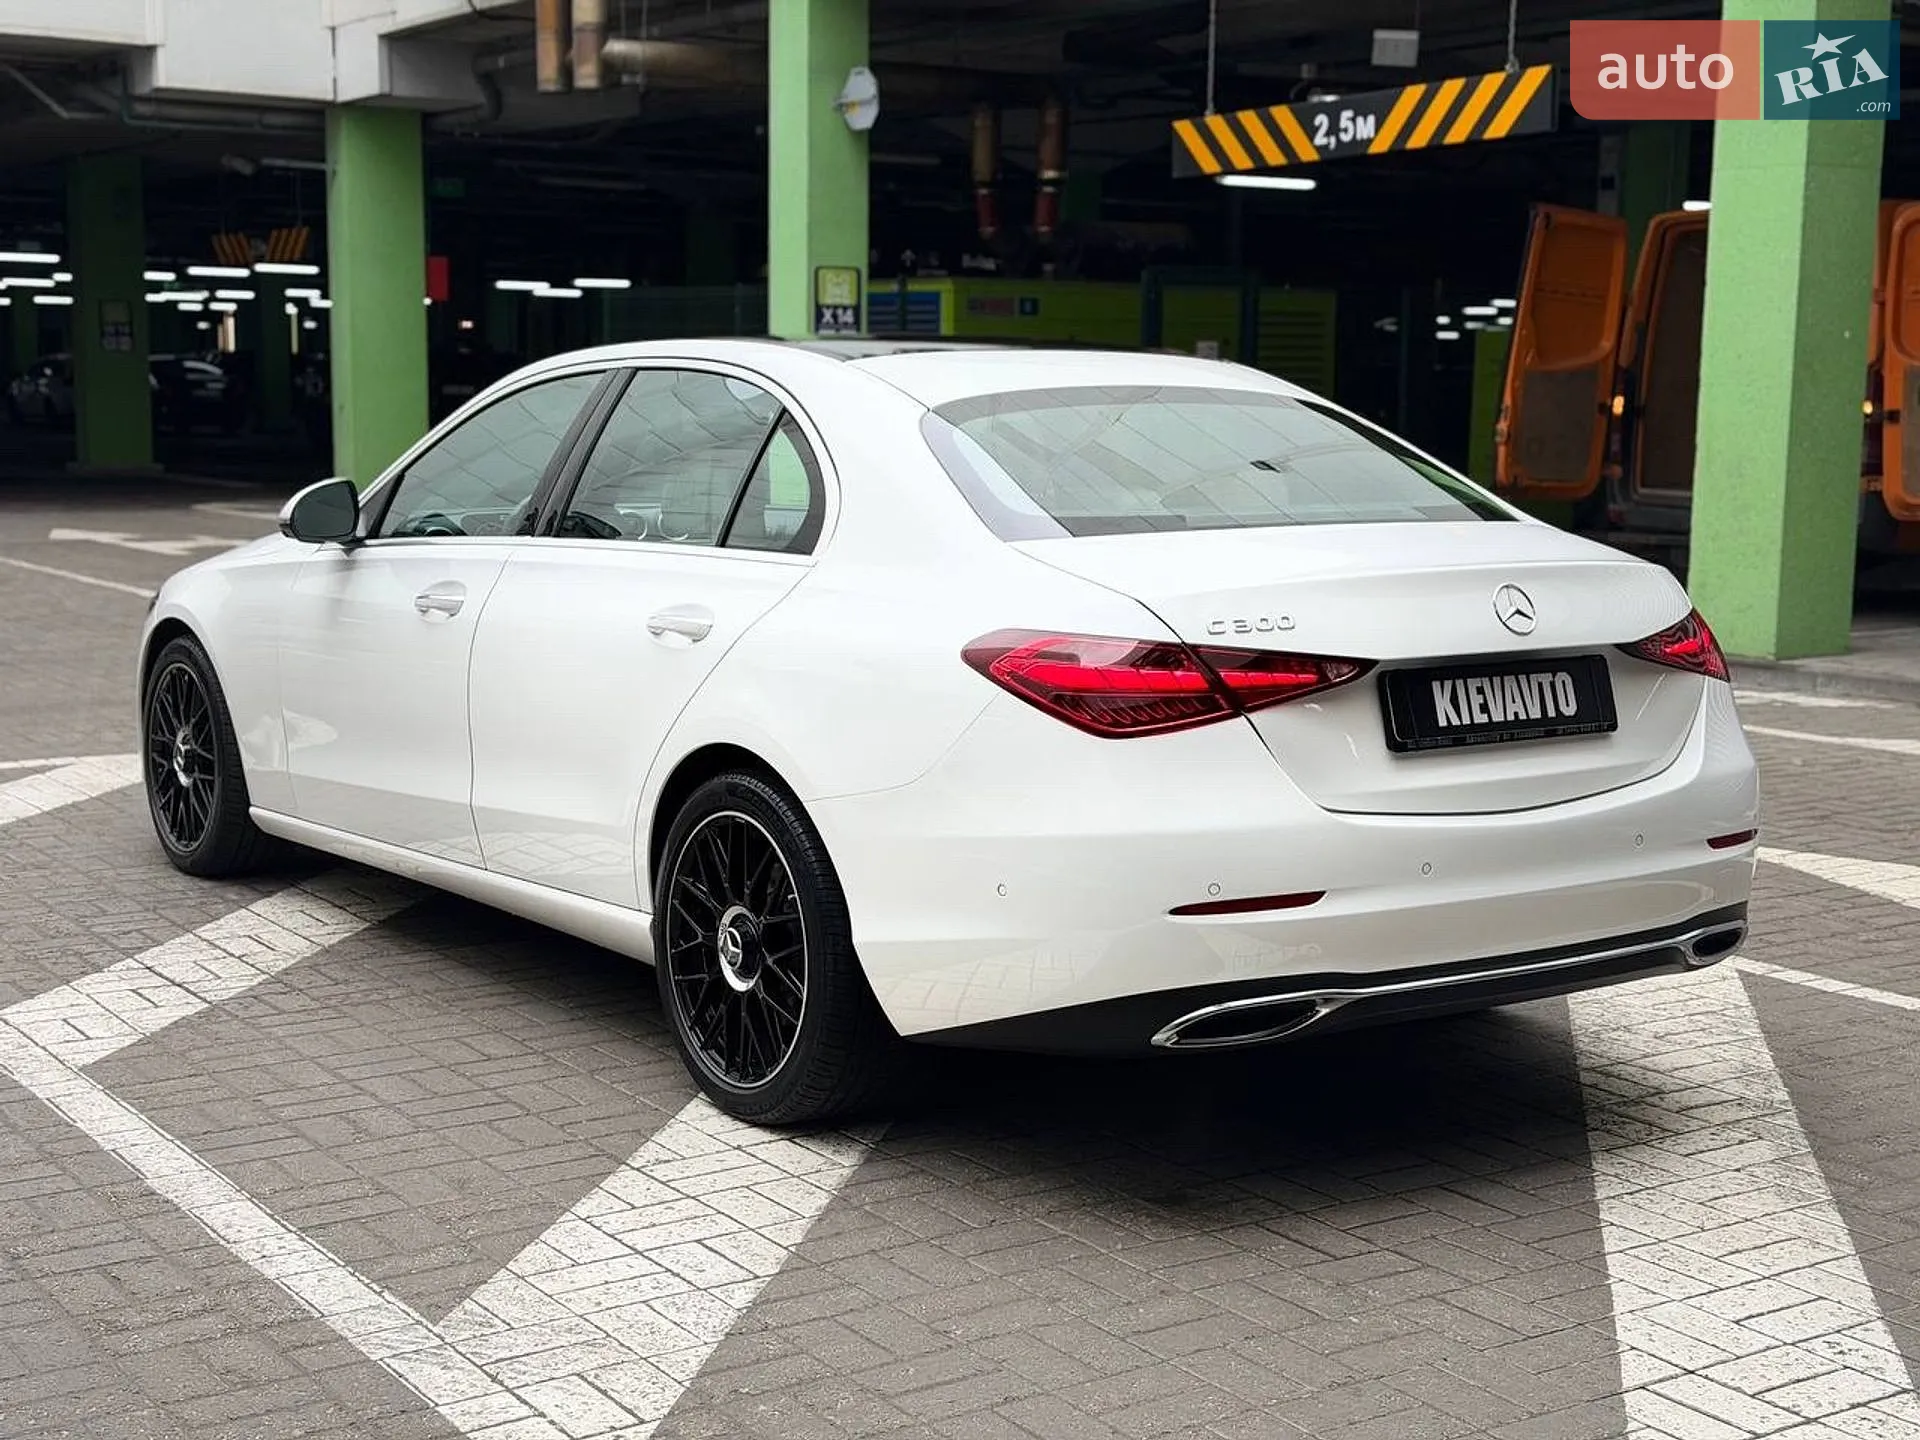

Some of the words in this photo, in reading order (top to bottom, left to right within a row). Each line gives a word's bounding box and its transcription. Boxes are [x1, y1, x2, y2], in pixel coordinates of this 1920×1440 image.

[1206, 615, 1227, 636] C
[1232, 612, 1296, 634] 300
[1431, 671, 1579, 728] KIEVAVTO
